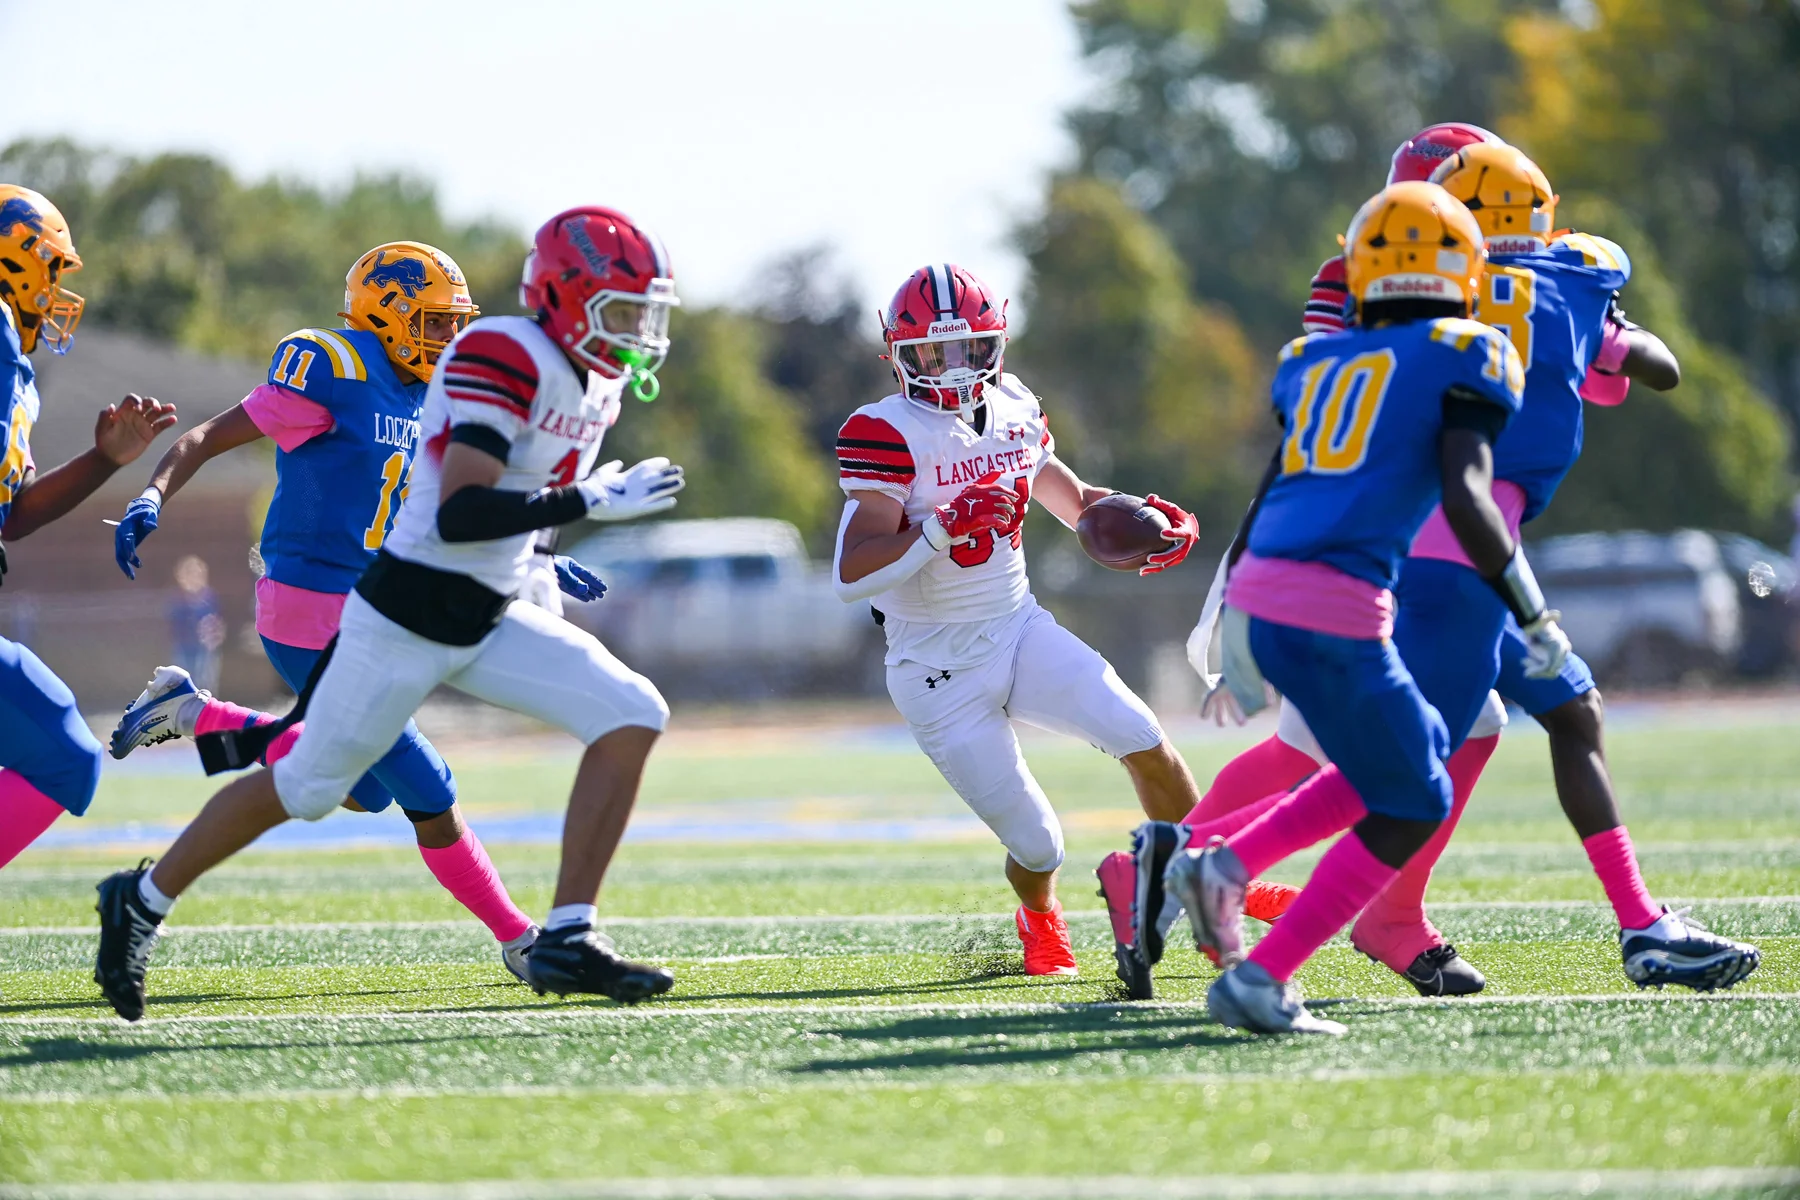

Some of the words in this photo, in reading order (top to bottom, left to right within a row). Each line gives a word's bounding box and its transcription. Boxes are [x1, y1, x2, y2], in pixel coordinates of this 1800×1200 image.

[1488, 238, 1536, 253] iddell
[1381, 278, 1444, 293] Riddell
[931, 322, 968, 335] Riddell
[272, 343, 317, 391] 11
[1280, 347, 1397, 476] 10
[935, 448, 1036, 487] LANCASTER
